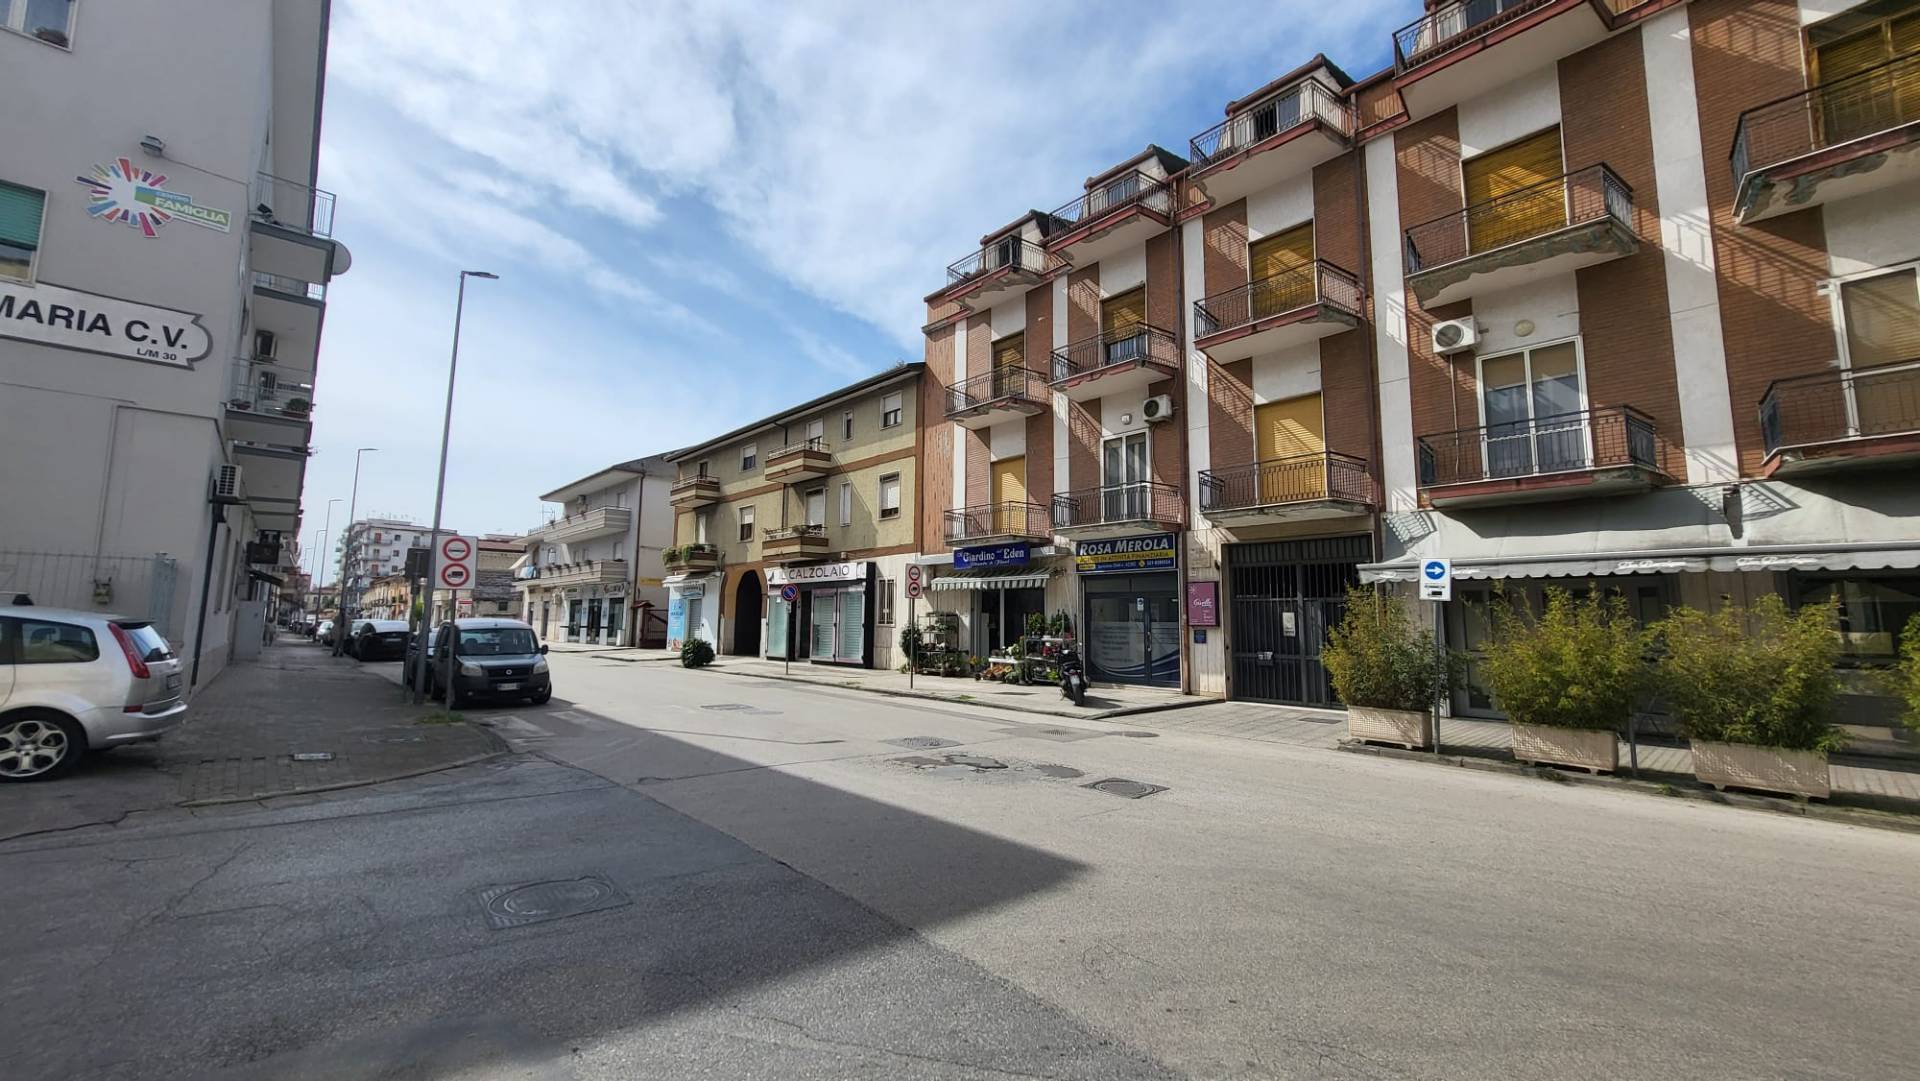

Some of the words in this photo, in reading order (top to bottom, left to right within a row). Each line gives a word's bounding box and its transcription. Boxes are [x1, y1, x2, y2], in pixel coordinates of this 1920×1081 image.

[154, 197, 227, 224] FAMIGLIA
[125, 320, 188, 350] C.V.
[136, 347, 159, 358] L/M
[162, 352, 177, 361] 30
[962, 551, 995, 562] Giardino
[1003, 547, 1025, 559] Eden
[1080, 543, 1112, 556] ROSA
[1114, 538, 1169, 553] MEROLA
[788, 564, 850, 580] CALZOLAIO
